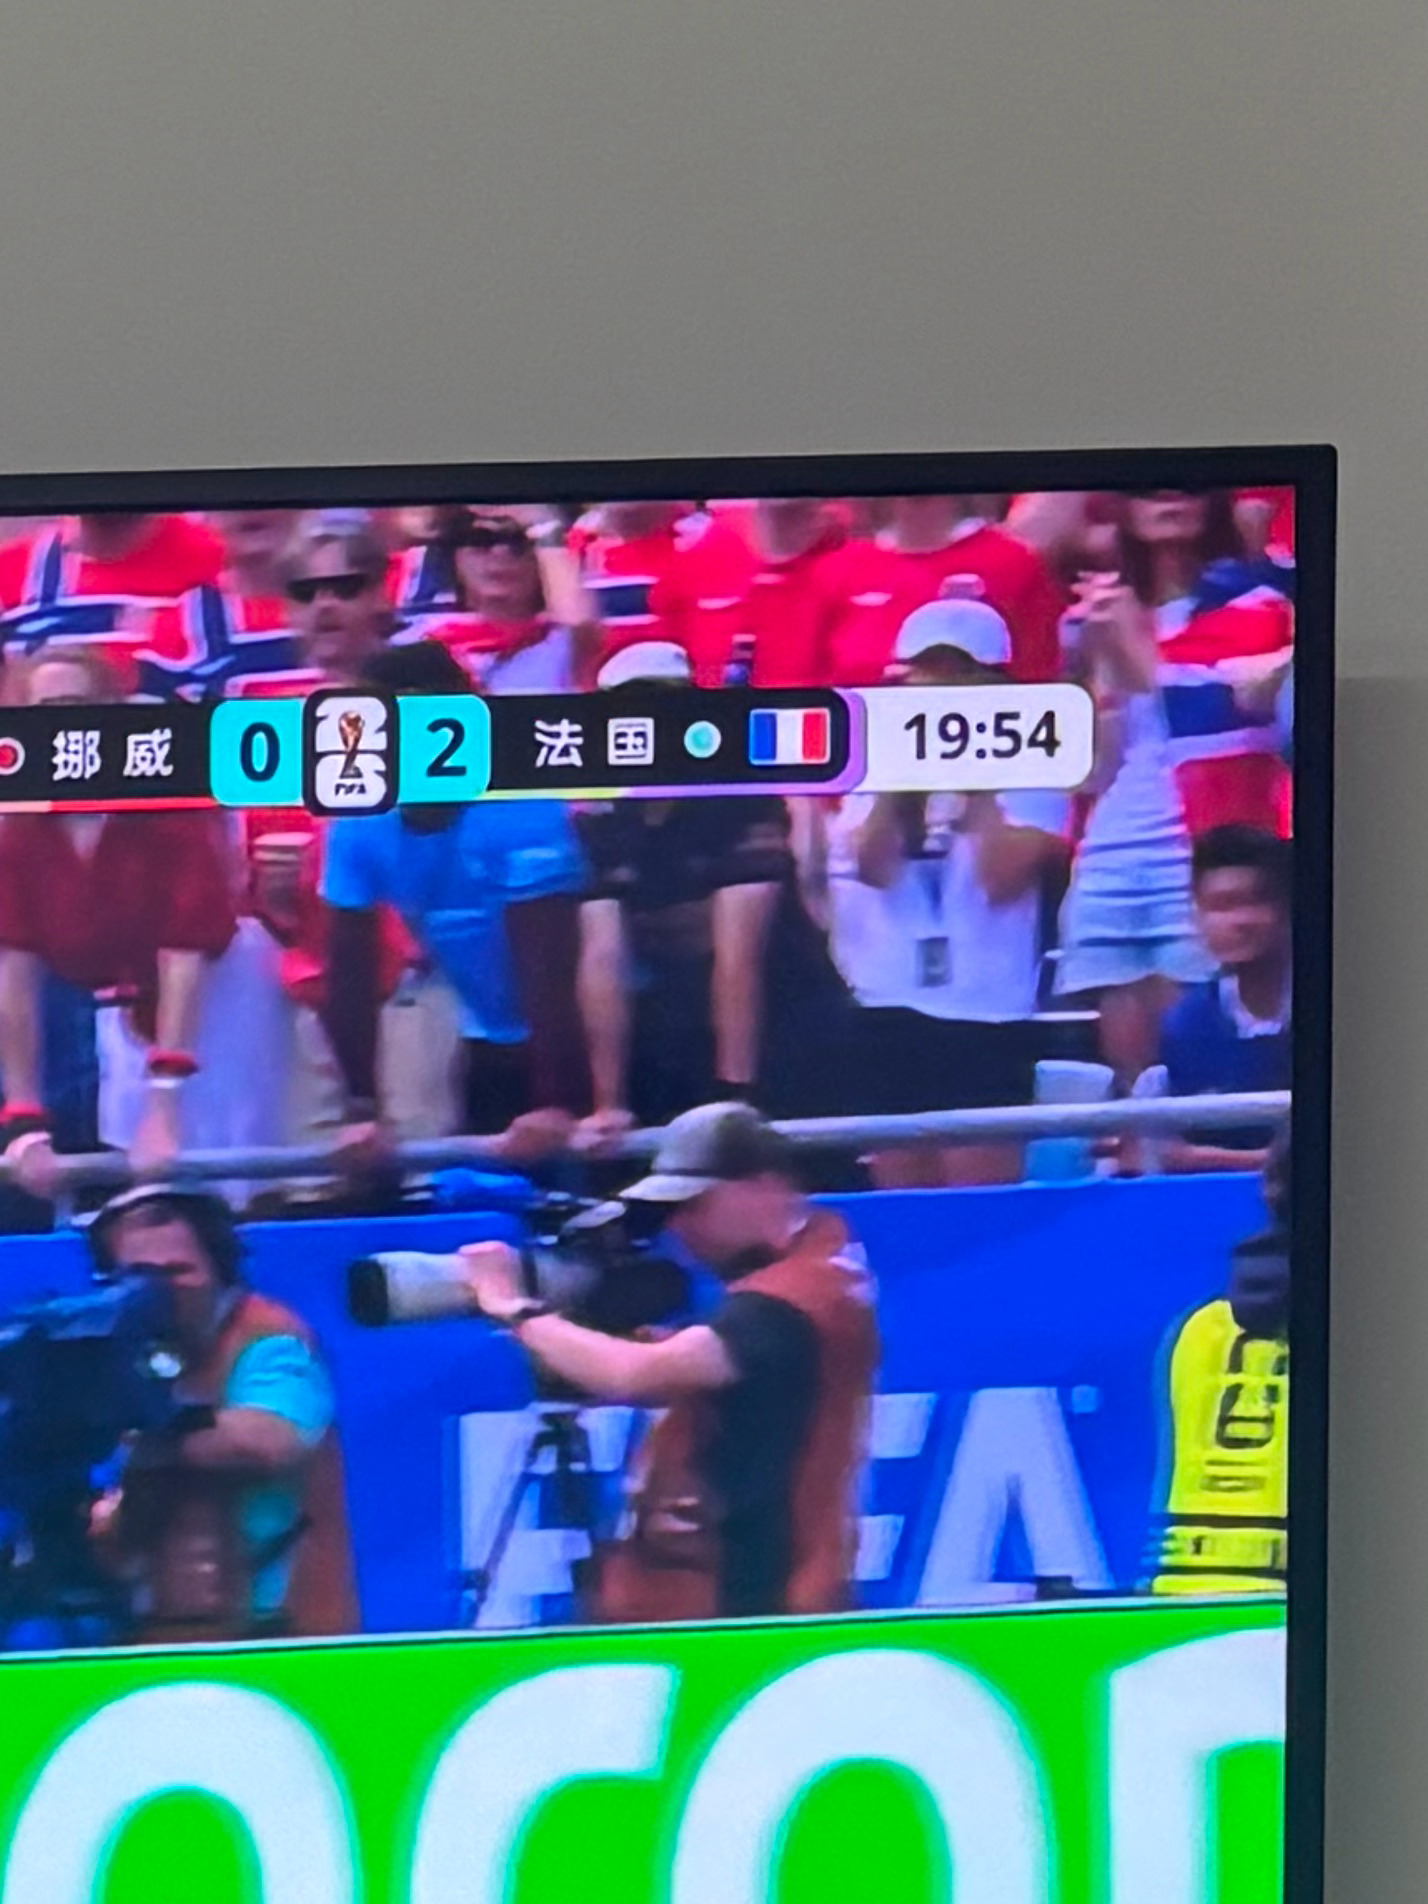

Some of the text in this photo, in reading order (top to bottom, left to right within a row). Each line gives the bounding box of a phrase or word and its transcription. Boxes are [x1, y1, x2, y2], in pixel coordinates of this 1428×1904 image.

[239, 720, 281, 783] 0
[424, 718, 472, 778] 2
[904, 710, 1060, 761] 19:54
[333, 783, 368, 797] FIFA
